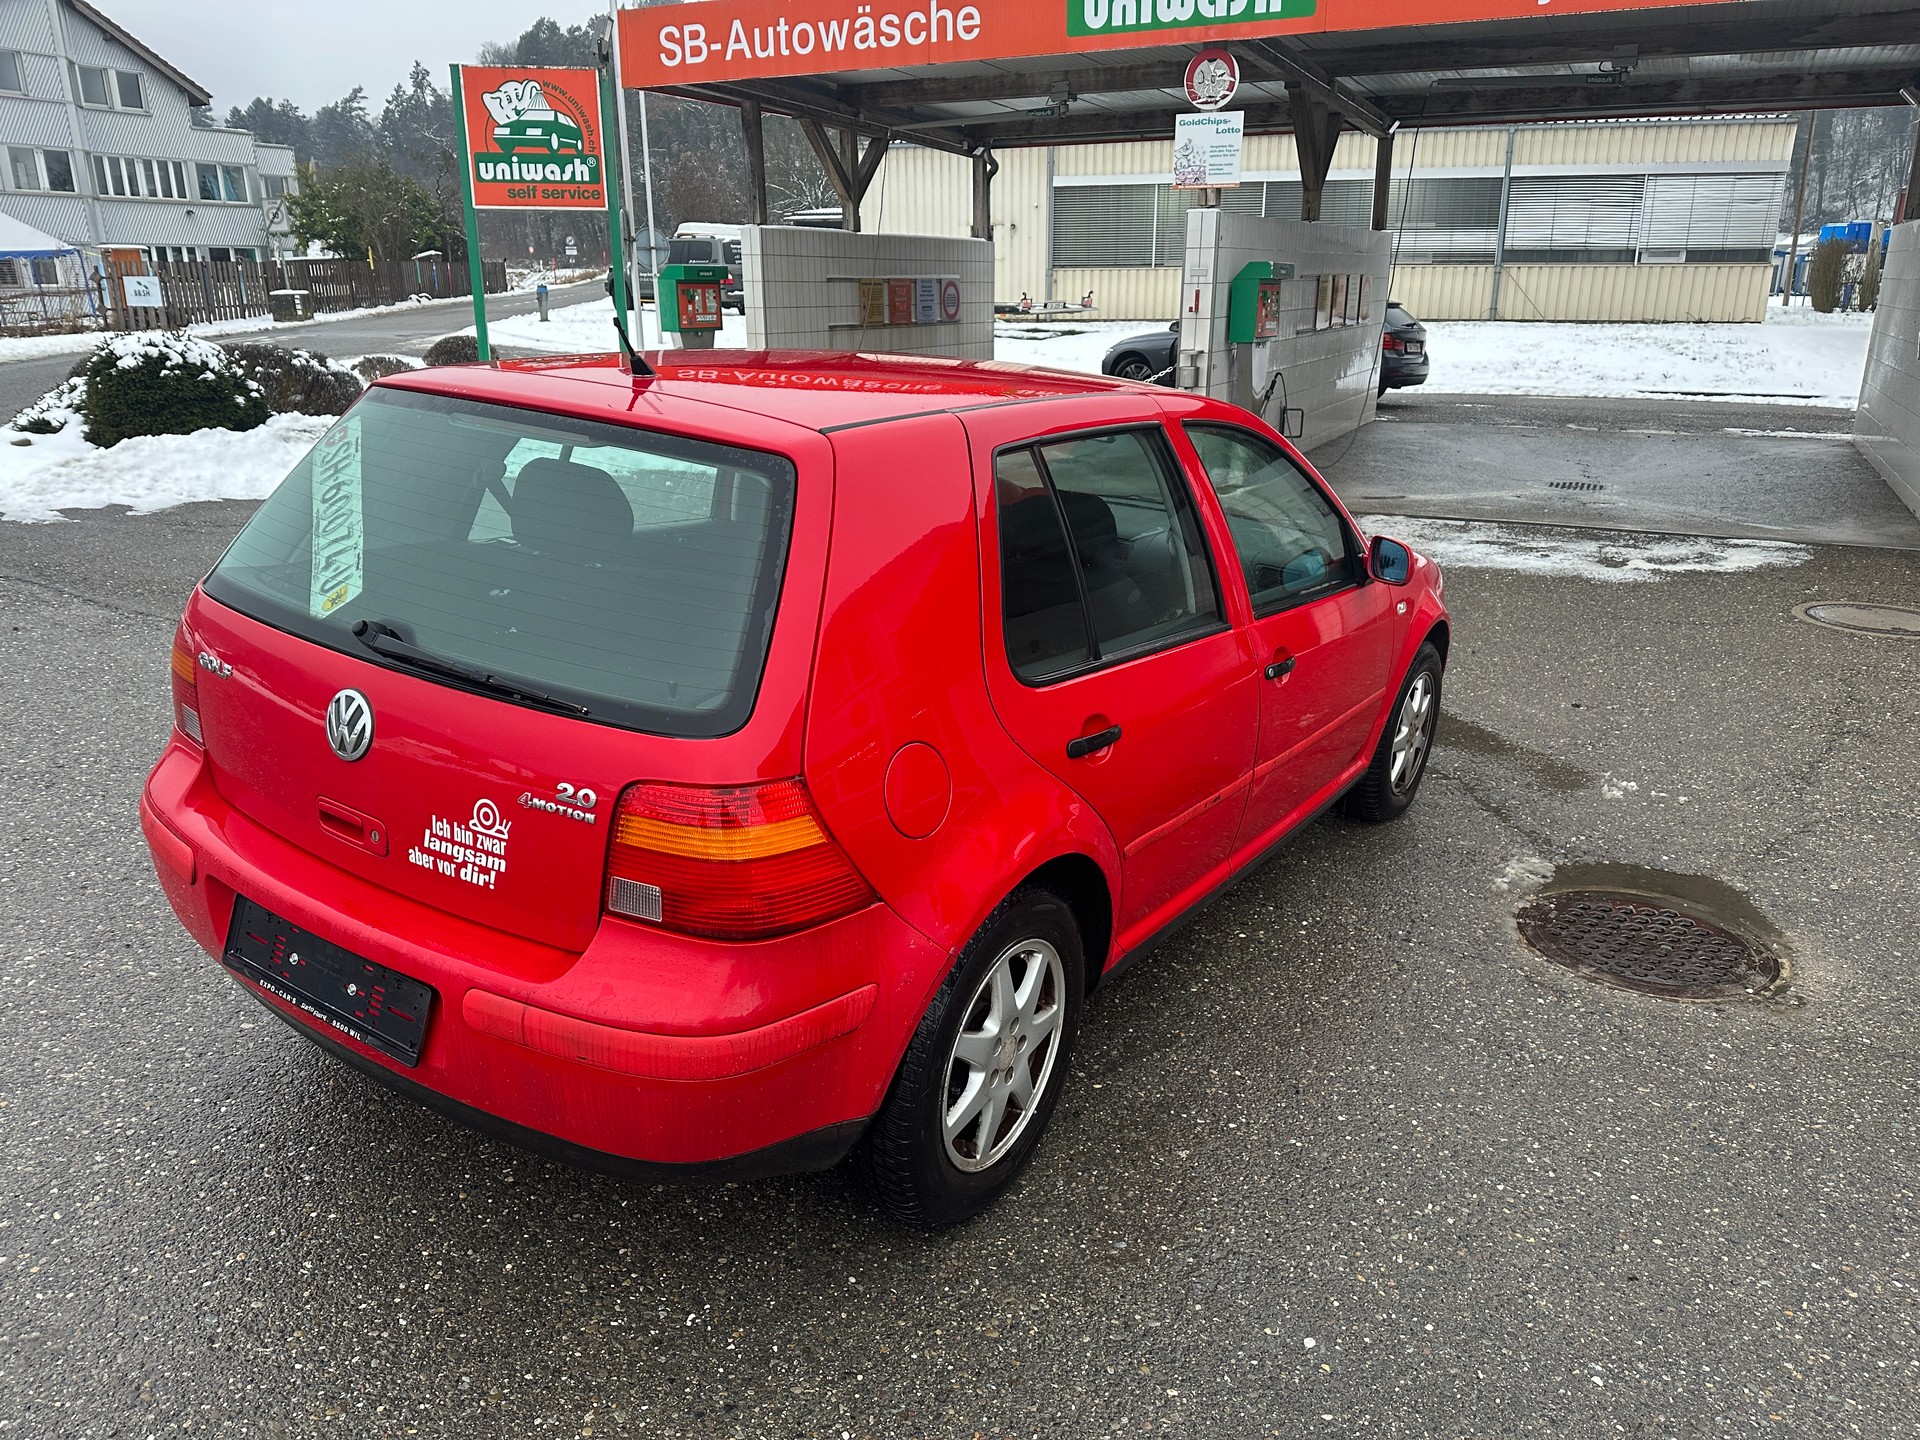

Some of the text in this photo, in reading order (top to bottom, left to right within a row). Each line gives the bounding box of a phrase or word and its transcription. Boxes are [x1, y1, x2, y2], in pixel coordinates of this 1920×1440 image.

[659, 1, 982, 67] SB-Autowäsche
[543, 80, 597, 153] www.uniwash.ch
[1179, 116, 1231, 127] GoldChips-
[507, 185, 601, 200] self service
[198, 651, 234, 680] GOLF
[423, 828, 507, 872] langsam
[431, 814, 507, 856] Ich bin zwar
[408, 846, 497, 890] aber vor dir!
[331, 1019, 349, 1033] 9500
[349, 1028, 361, 1041] WIL
